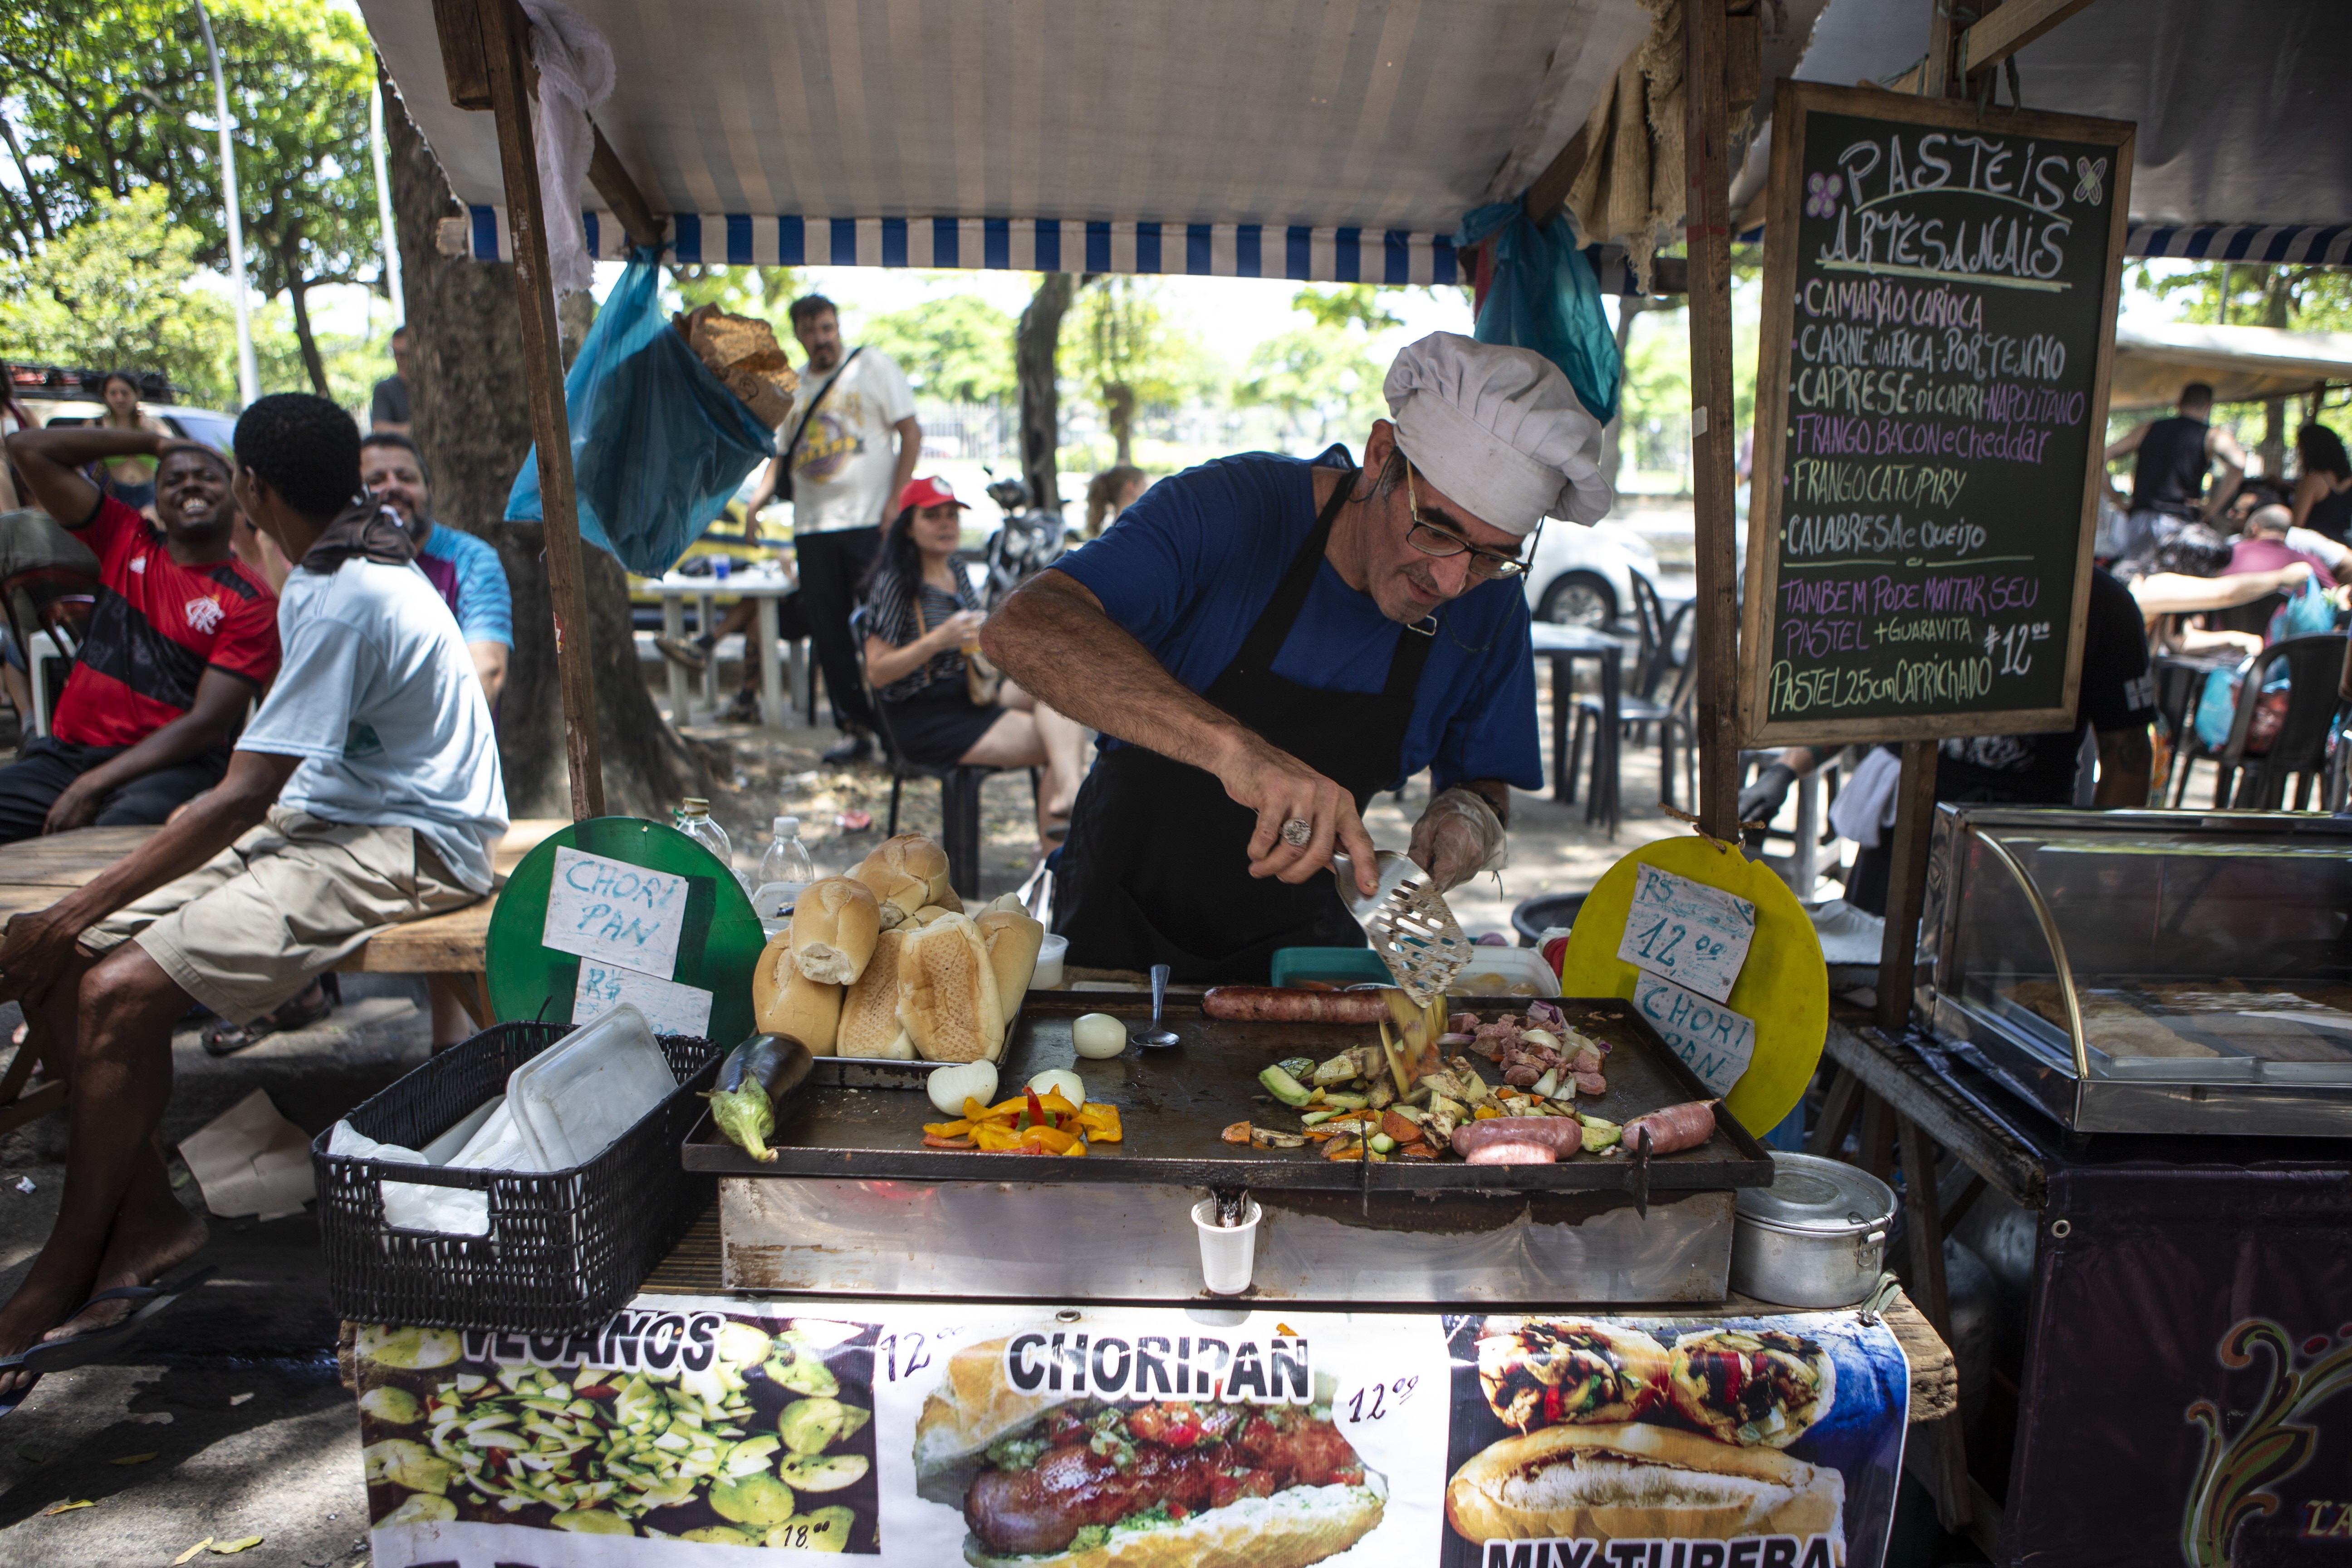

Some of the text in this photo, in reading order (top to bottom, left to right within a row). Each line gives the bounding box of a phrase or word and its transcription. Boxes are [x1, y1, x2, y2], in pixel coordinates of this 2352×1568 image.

[1800, 322, 1874, 367] CARNE
[1891, 327, 1934, 374] FACA
[1795, 413, 1871, 455] FRANGO
[1875, 417, 1941, 456] BACON
[1793, 457, 1866, 505] FRANGO
[1787, 512, 1903, 556] CALABRESA
[1779, 575, 2039, 617] TAMBEM PODE MONTAR SEU
[1781, 618, 1870, 659] PASTEL
[1769, 660, 1845, 715] PASTEL
[1640, 872, 1675, 908] R$
[577, 903, 662, 946] PAN
[585, 967, 625, 1003] R$
